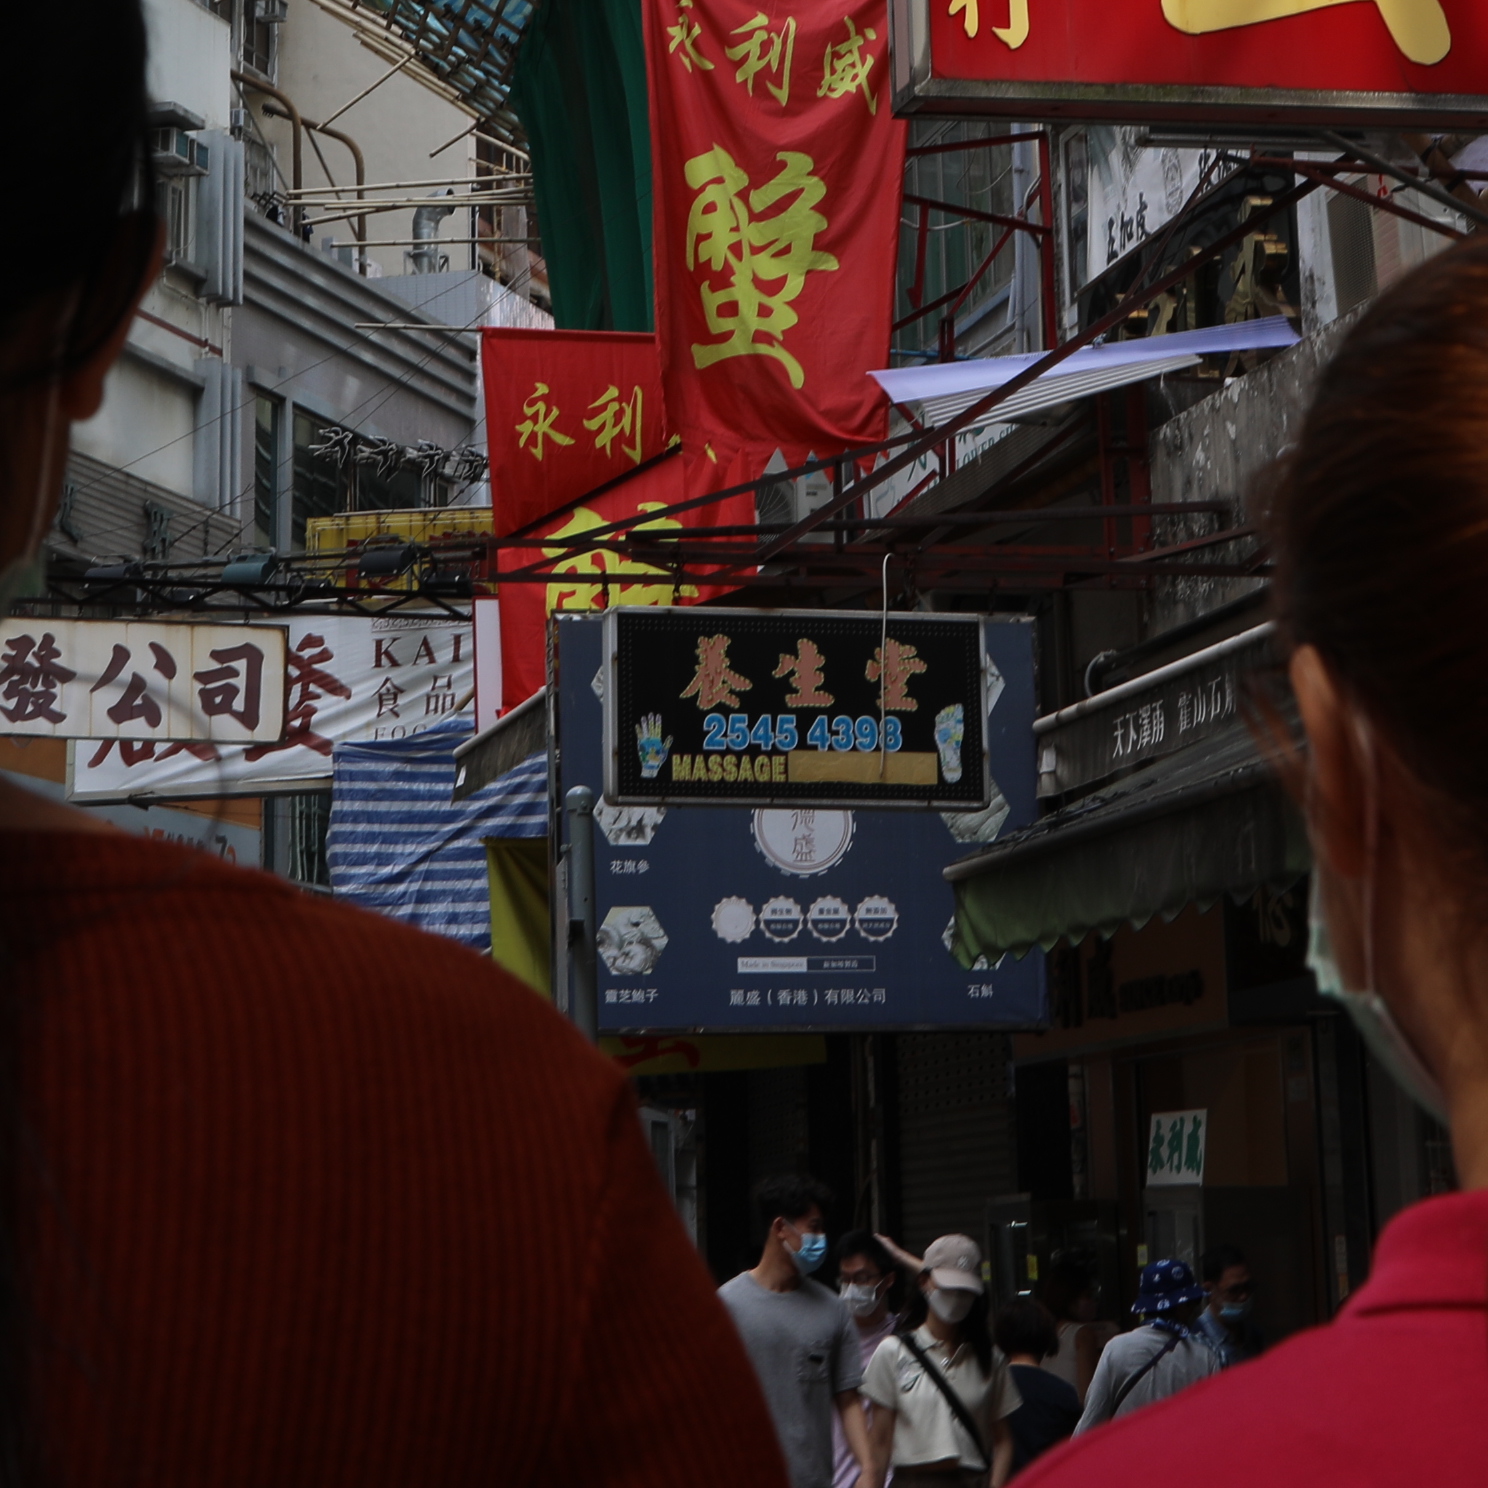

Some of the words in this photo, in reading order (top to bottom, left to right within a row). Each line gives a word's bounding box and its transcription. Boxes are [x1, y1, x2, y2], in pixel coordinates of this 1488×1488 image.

[684, 142, 840, 390] 蟹
[514, 381, 684, 466] 永利
[372, 634, 463, 668] KAI
[679, 633, 928, 711] 養生堂
[371, 674, 456, 719] 食品
[702, 713, 799, 751] 2545
[806, 714, 904, 753] 4398
[671, 754, 787, 783] MASSAGE
